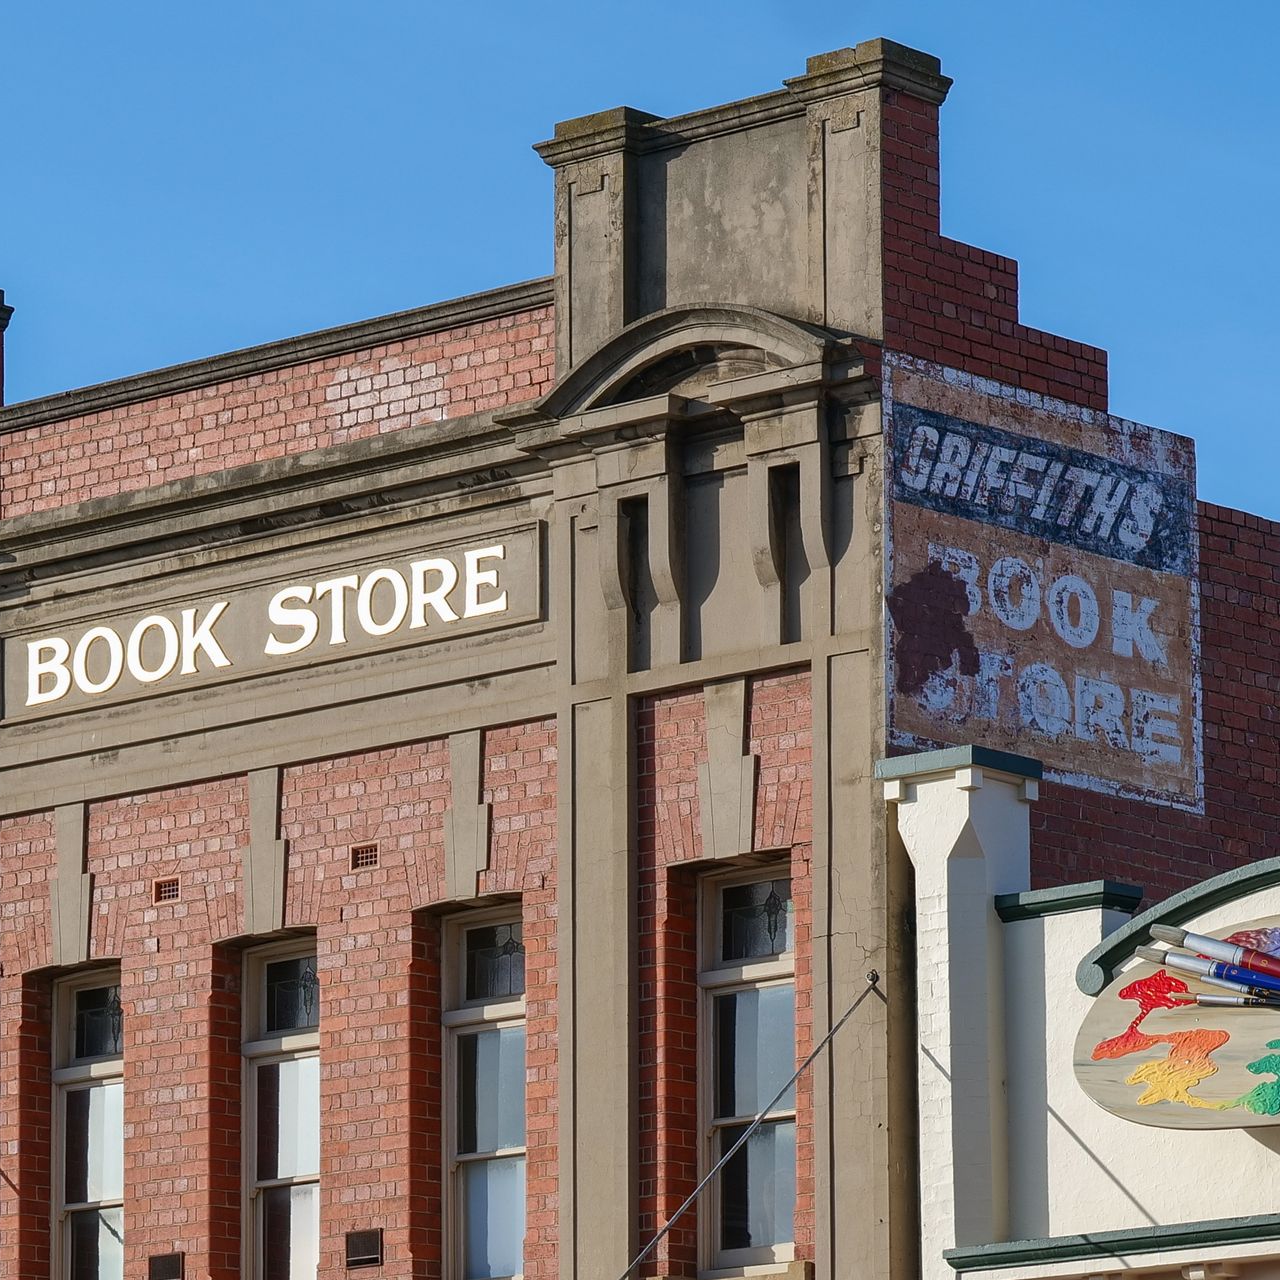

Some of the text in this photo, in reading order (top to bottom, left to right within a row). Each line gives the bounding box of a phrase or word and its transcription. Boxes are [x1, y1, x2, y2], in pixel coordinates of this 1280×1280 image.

[899, 425, 1163, 551] GRIFFITHS
[25, 544, 508, 707] BOOK STORE
[927, 541, 1168, 673] BOOK
